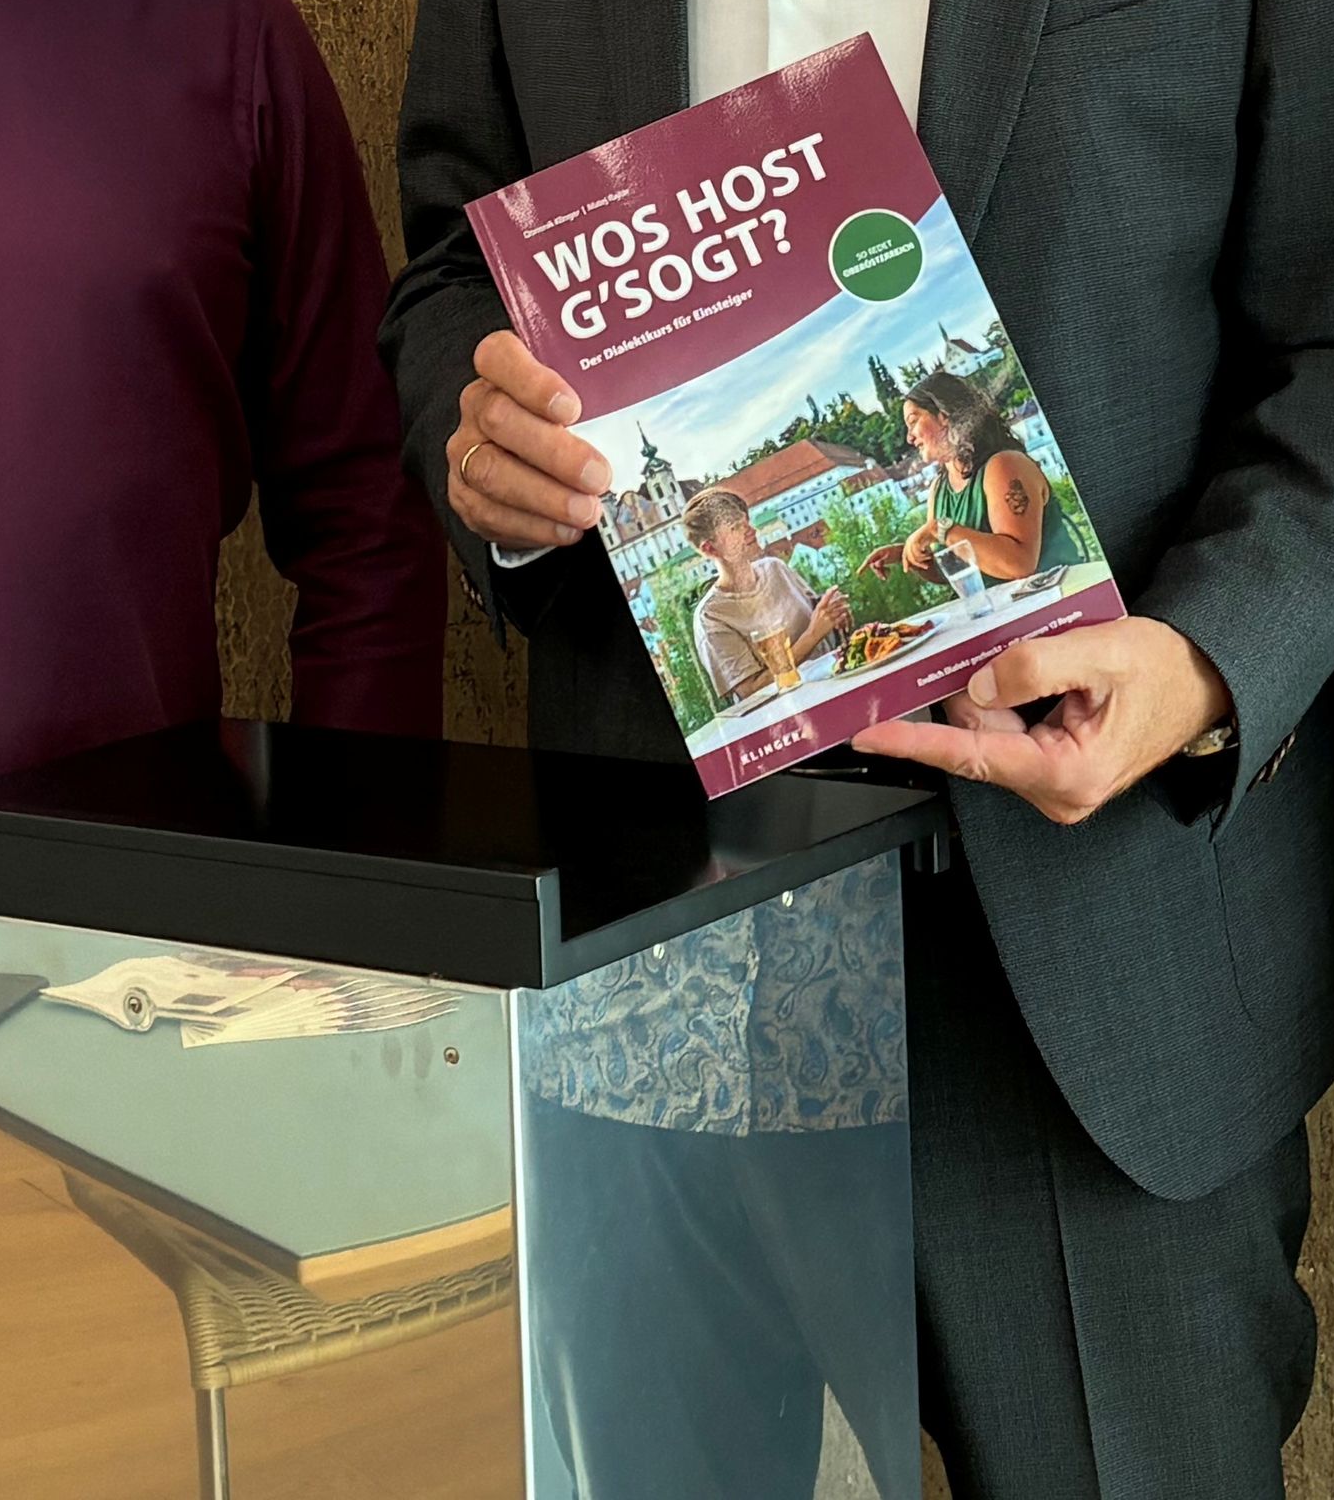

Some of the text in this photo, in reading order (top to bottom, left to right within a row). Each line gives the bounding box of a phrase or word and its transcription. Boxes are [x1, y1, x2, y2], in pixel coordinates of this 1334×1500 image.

[533, 132, 827, 292] WOS HOST
[560, 209, 792, 339] G'SOGT?
[579, 289, 753, 371] Der Dialektkurs für Einsteiger
